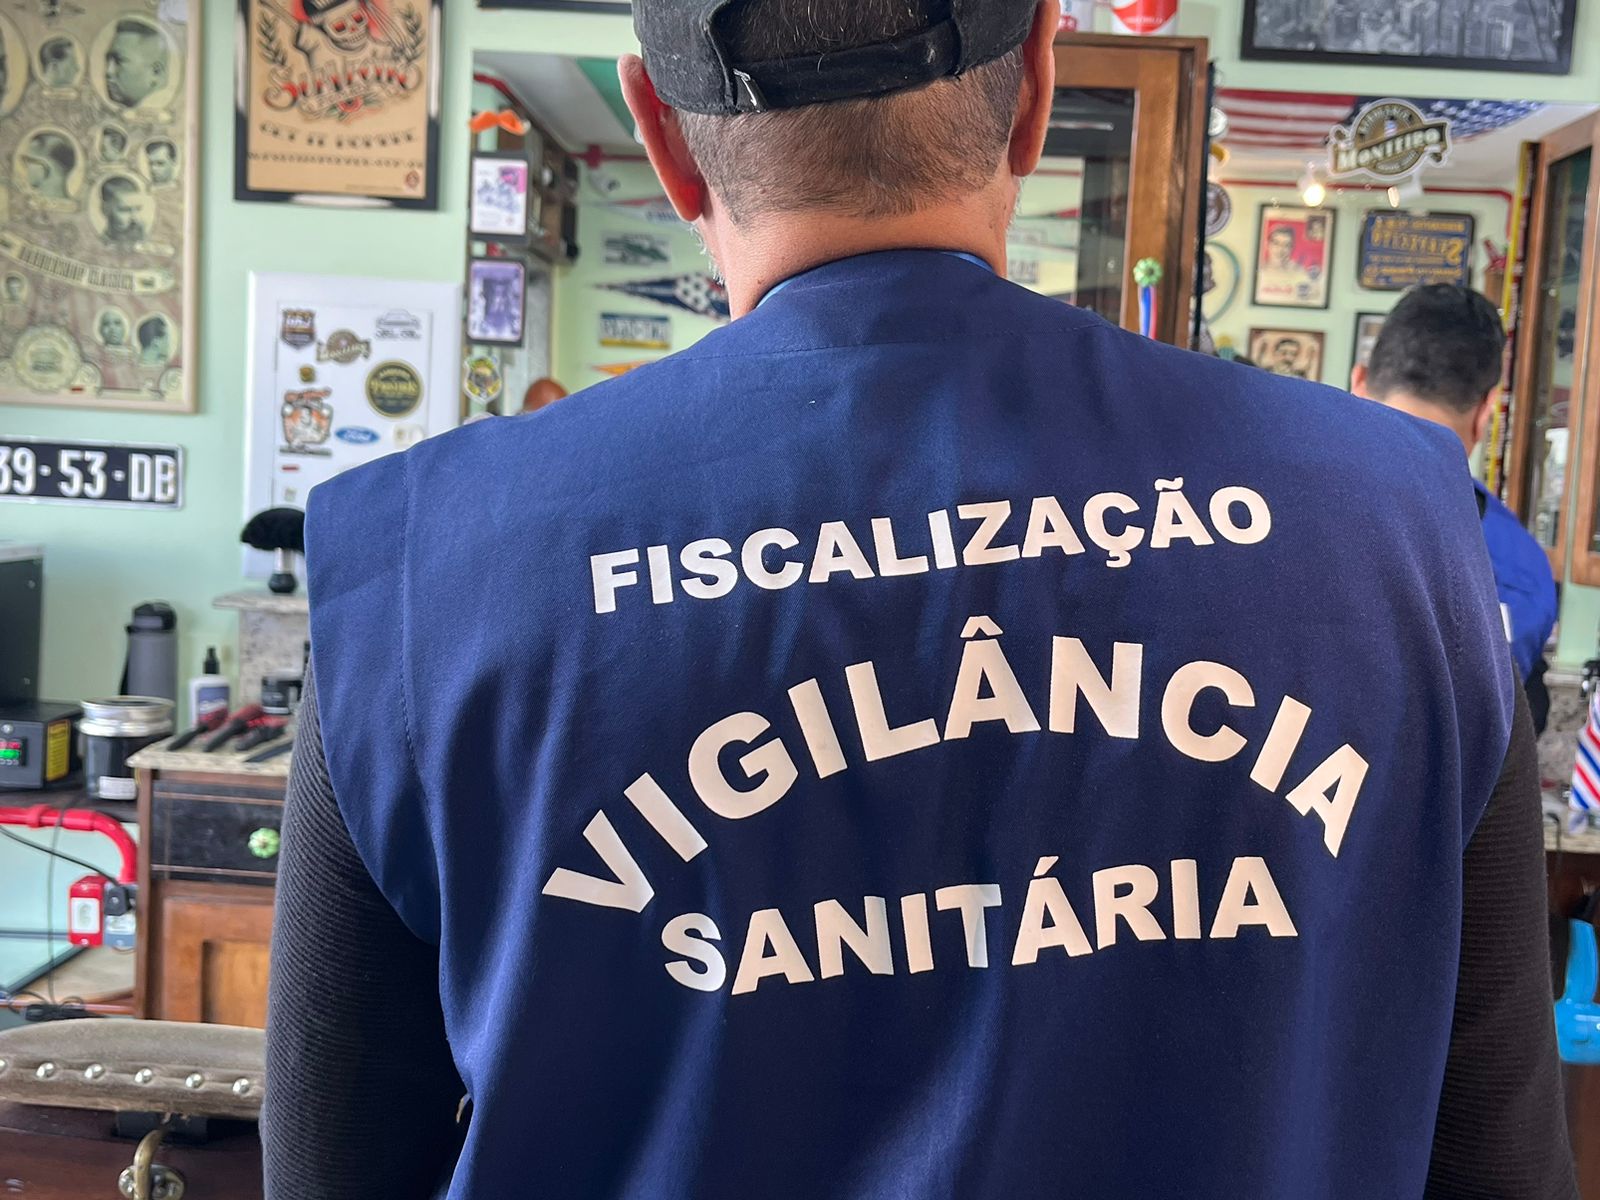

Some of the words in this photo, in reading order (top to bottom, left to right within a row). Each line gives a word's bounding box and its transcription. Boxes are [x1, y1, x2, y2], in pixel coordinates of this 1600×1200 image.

[591, 477, 1271, 613] FISCALIZAÇÃO
[542, 616, 1369, 913] VIGILÂNCIA
[662, 856, 1298, 994] SANITÁRIA
